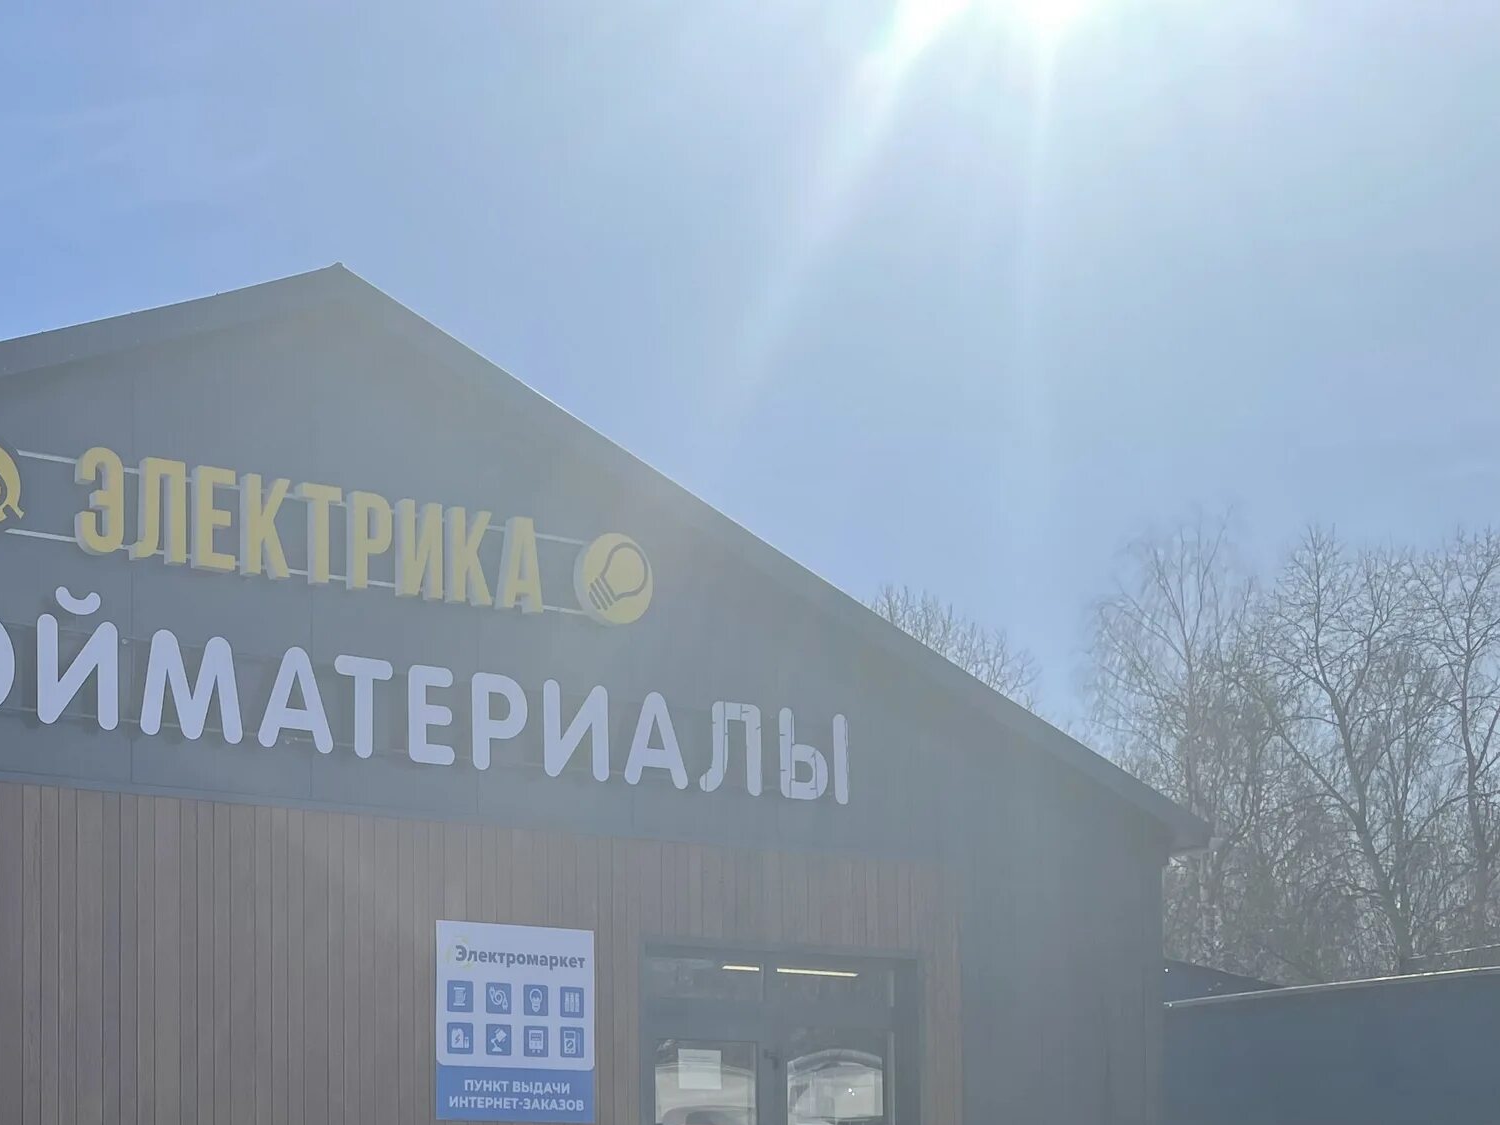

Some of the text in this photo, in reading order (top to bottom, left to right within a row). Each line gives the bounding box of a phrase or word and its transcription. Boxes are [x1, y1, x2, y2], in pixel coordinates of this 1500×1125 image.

[74, 446, 545, 614] ЭЛЕКТРИКА
[455, 944, 586, 970] Электромаркет
[464, 1079, 570, 1095] ПУНКТ ВЫДАЧИ
[449, 1096, 584, 1111] ИНТЕРНЕТ-ЗАКАЗОВ
